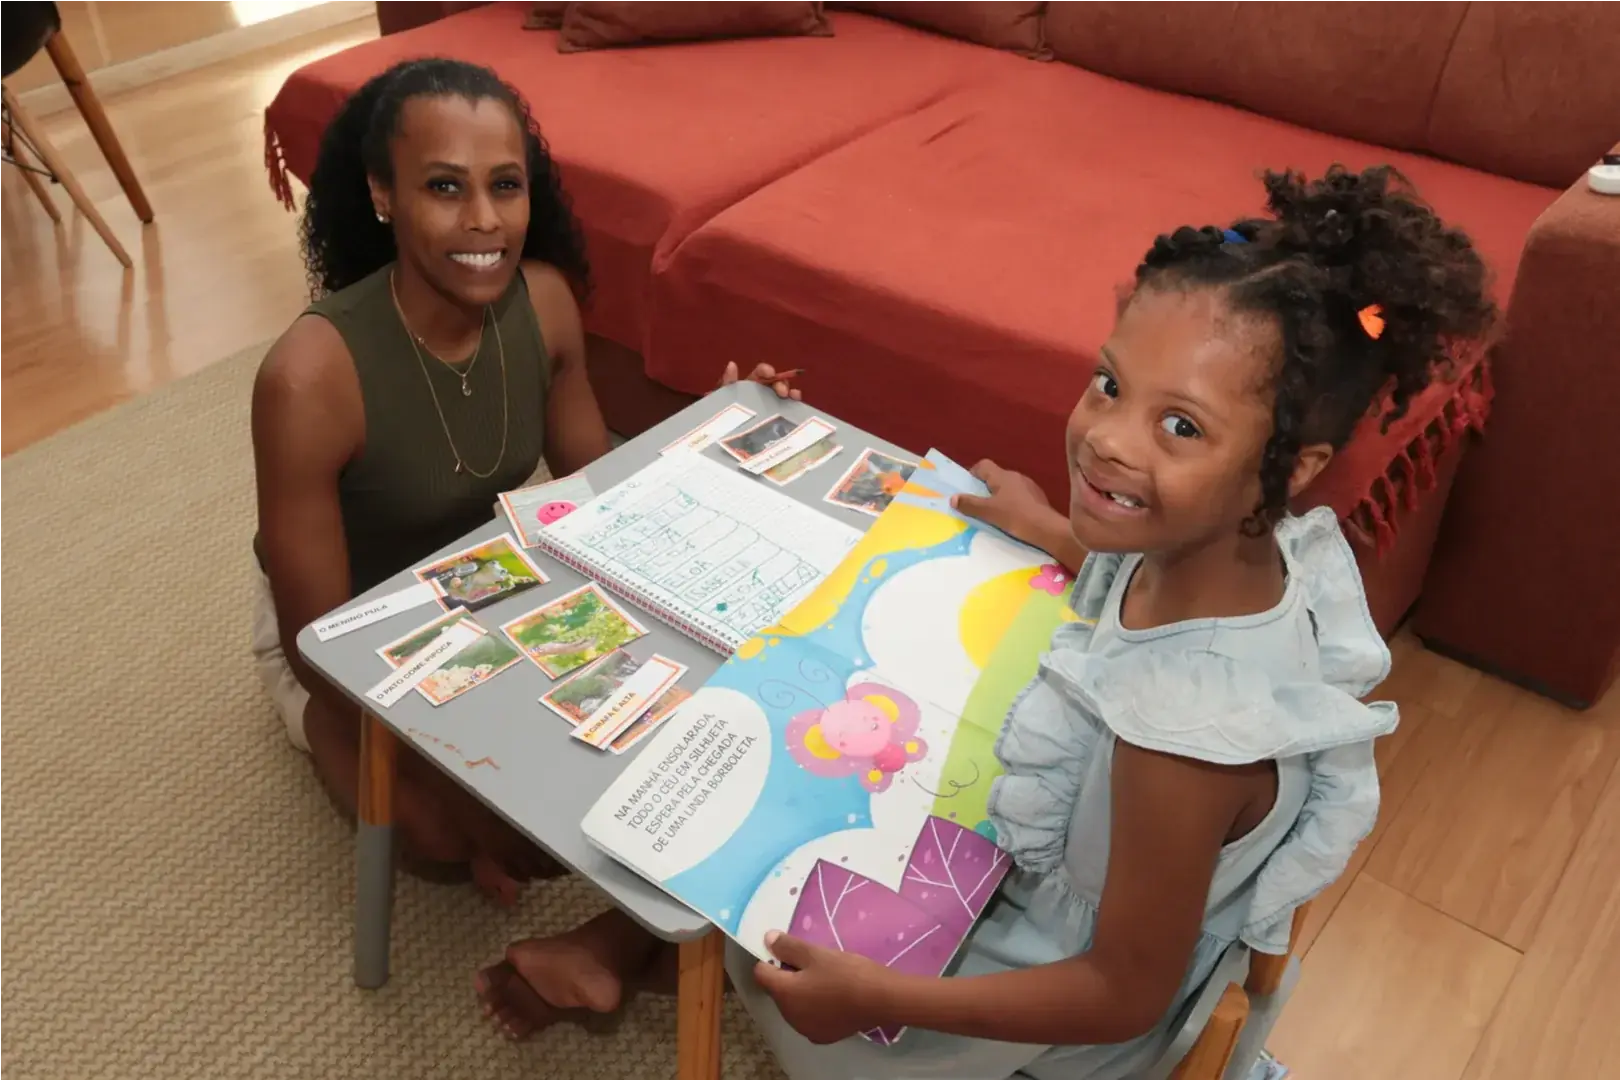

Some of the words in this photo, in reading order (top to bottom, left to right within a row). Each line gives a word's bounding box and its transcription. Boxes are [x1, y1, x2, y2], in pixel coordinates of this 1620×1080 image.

[328, 614, 364, 630] MENINO
[364, 604, 388, 618] PULA
[383, 679, 405, 695] PATO
[403, 663, 425, 680] COME
[425, 641, 453, 664] PIPOCA
[589, 711, 616, 733] GIRAFA
[618, 692, 636, 708] ALTA
[613, 804, 632, 821] NA
[627, 770, 663, 806] MANHÃ
[627, 802, 655, 830] TODO
[652, 792, 662, 805] O
[659, 774, 681, 796] CÉU
[675, 761, 693, 778] EM
[688, 719, 729, 765] SILHUETA
[645, 799, 680, 836] ESPERA
[677, 774, 701, 800] PELA
[698, 732, 738, 777] CHEGADA
[651, 837, 669, 854] DE
[666, 816, 688, 839] UMA
[687, 788, 713, 818] LINDA
[707, 735, 758, 791] BORBOLETA.
